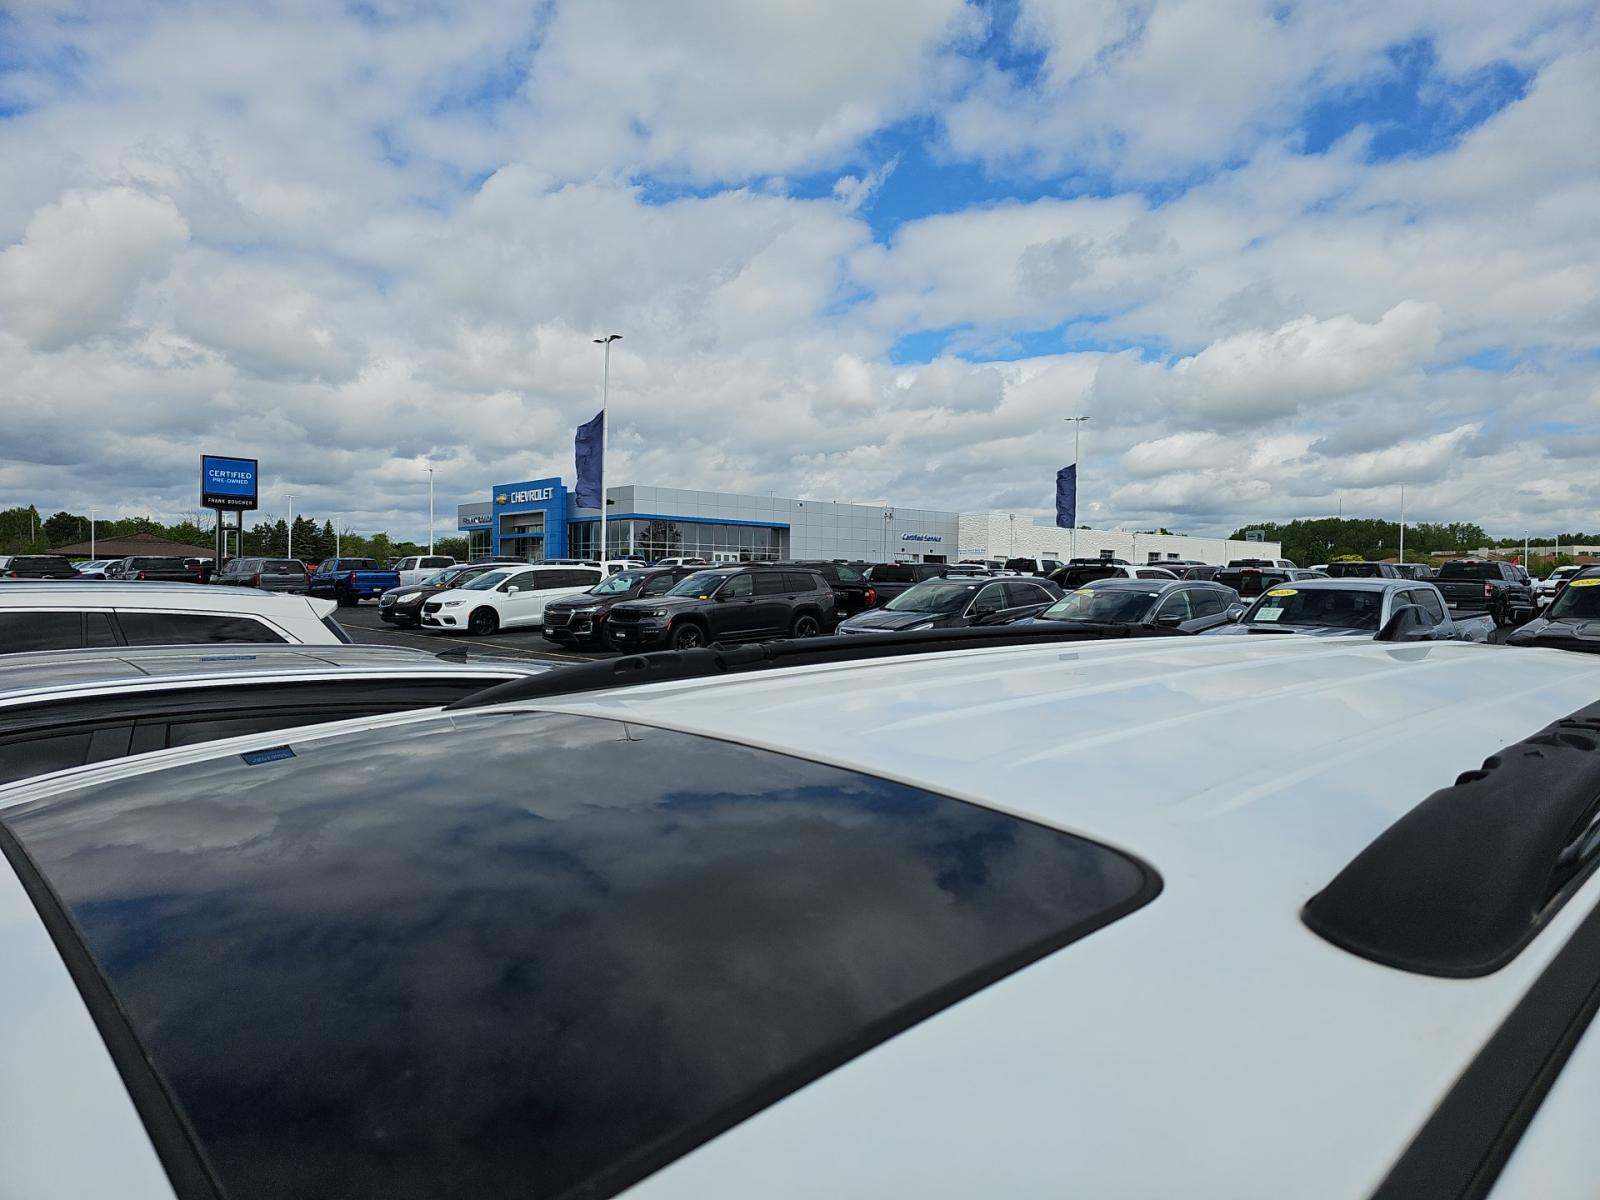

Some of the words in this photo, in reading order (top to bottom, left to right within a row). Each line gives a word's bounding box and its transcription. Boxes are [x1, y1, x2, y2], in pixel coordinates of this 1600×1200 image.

[208, 469, 252, 479] CERTIFIED
[212, 477, 249, 485] PRE-OWNED
[511, 487, 554, 503] CHEVROLET
